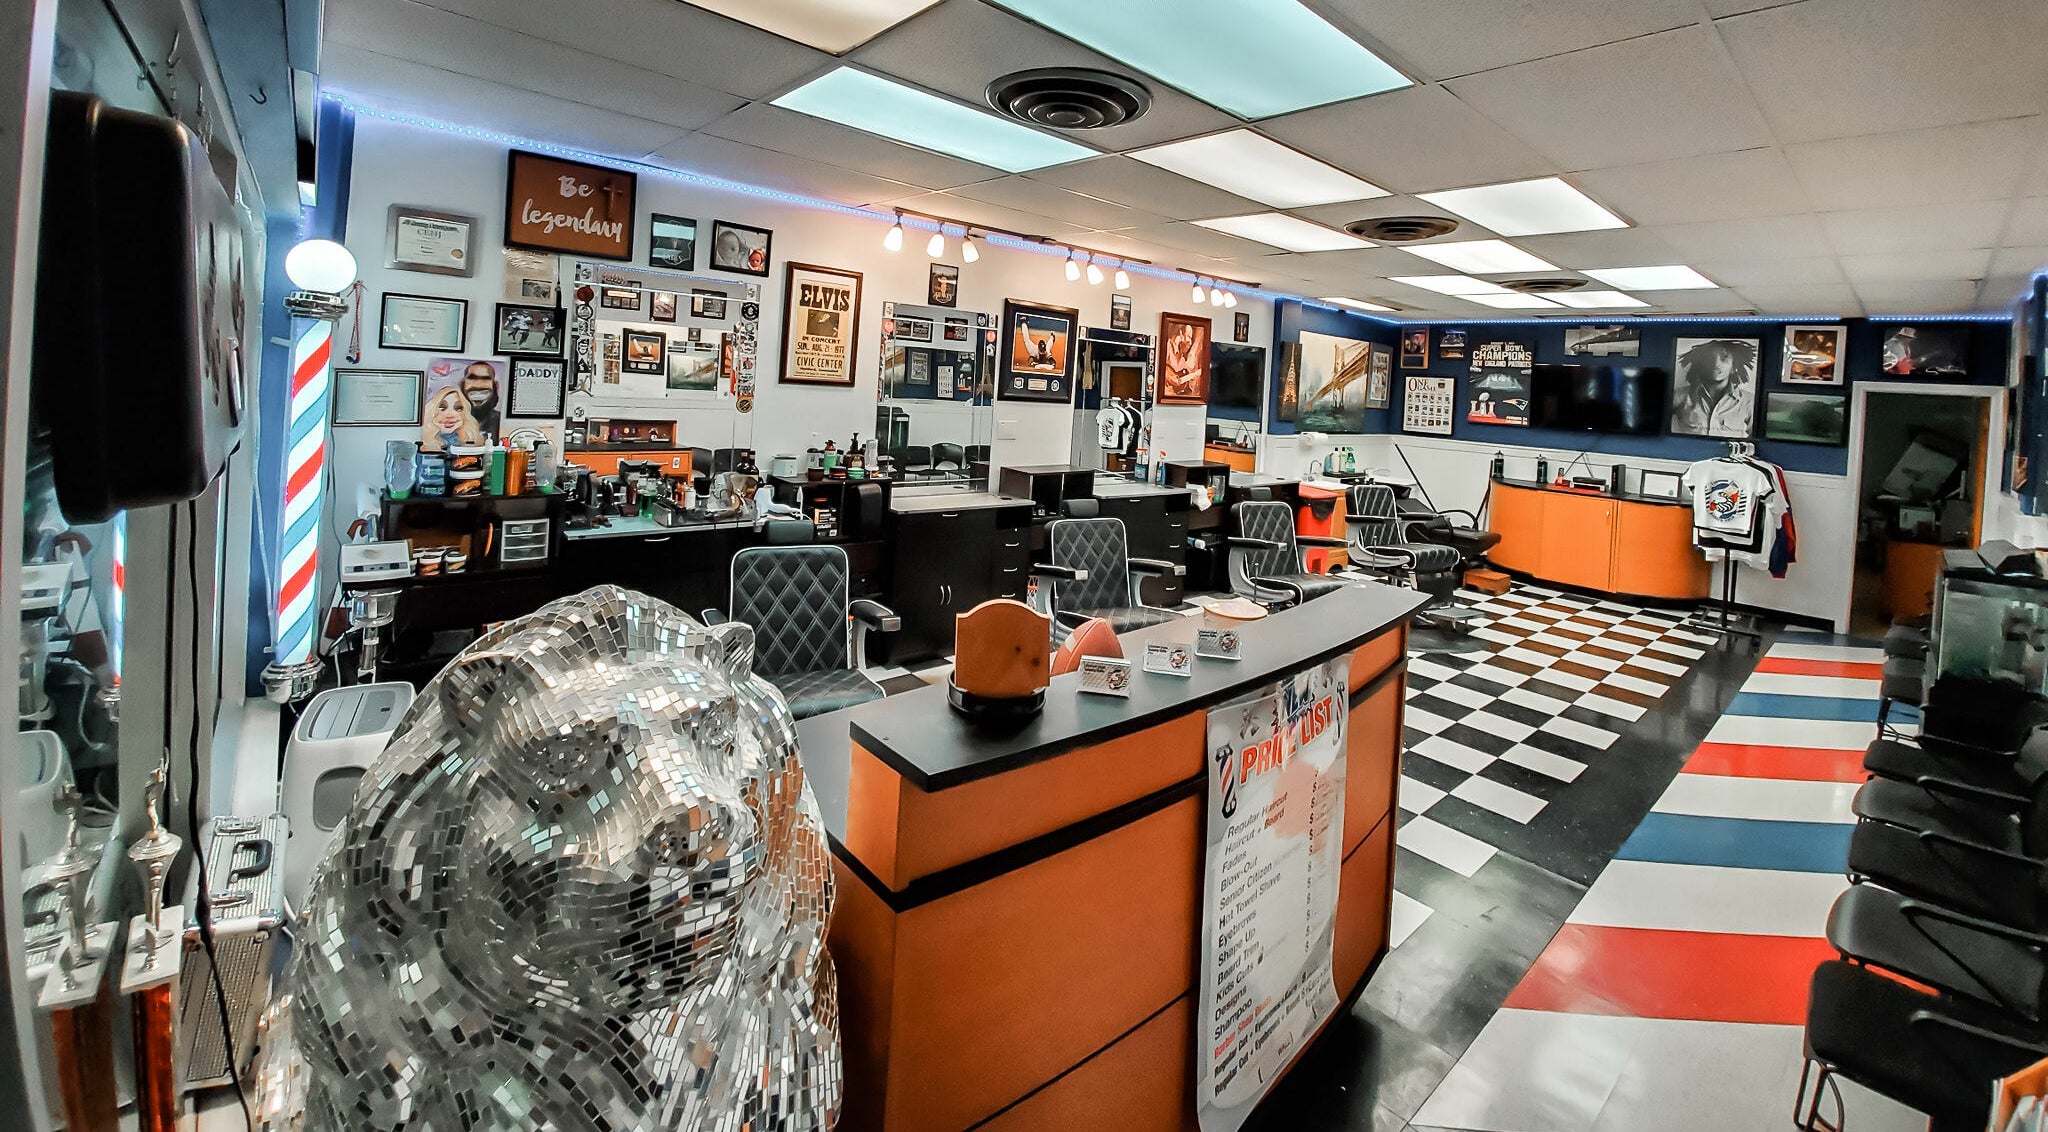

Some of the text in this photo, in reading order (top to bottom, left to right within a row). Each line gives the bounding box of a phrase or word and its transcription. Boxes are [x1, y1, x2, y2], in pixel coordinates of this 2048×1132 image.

[558, 175, 594, 197] Be
[521, 198, 623, 243] legendary
[799, 283, 850, 312] ELVIS
[811, 336, 841, 345] CONCERT
[1472, 350, 1532, 361] CHAMPIONS
[1480, 344, 1502, 352] SUPER
[518, 367, 560, 379] DADDY
[796, 356, 815, 367] CIVIC
[817, 357, 843, 370] CENTER
[1472, 359, 1483, 367] NEW
[1484, 360, 1507, 368] ENGLAND
[1300, 696, 1332, 746] LIST
[1225, 829, 1256, 856] Haircut
[1264, 807, 1285, 830] Beard
[1227, 791, 1288, 839] Regular Haircut
[1221, 856, 1258, 893] Blow-Out
[1222, 850, 1247, 874] Fades
[1219, 872, 1281, 930] Hot Towel Shave
[1220, 862, 1273, 911] Senior Citizen
[1218, 909, 1257, 948] Eyebrows
[1218, 927, 1256, 967] Shape Up
[1217, 954, 1242, 986] Beard
[1215, 985, 1247, 1021] Designs
[1216, 980, 1235, 1004] Kids
[1214, 998, 1253, 1041] Shampoo
[1214, 1046, 1238, 1079] Regular
[1214, 1065, 1238, 1098] Regular
